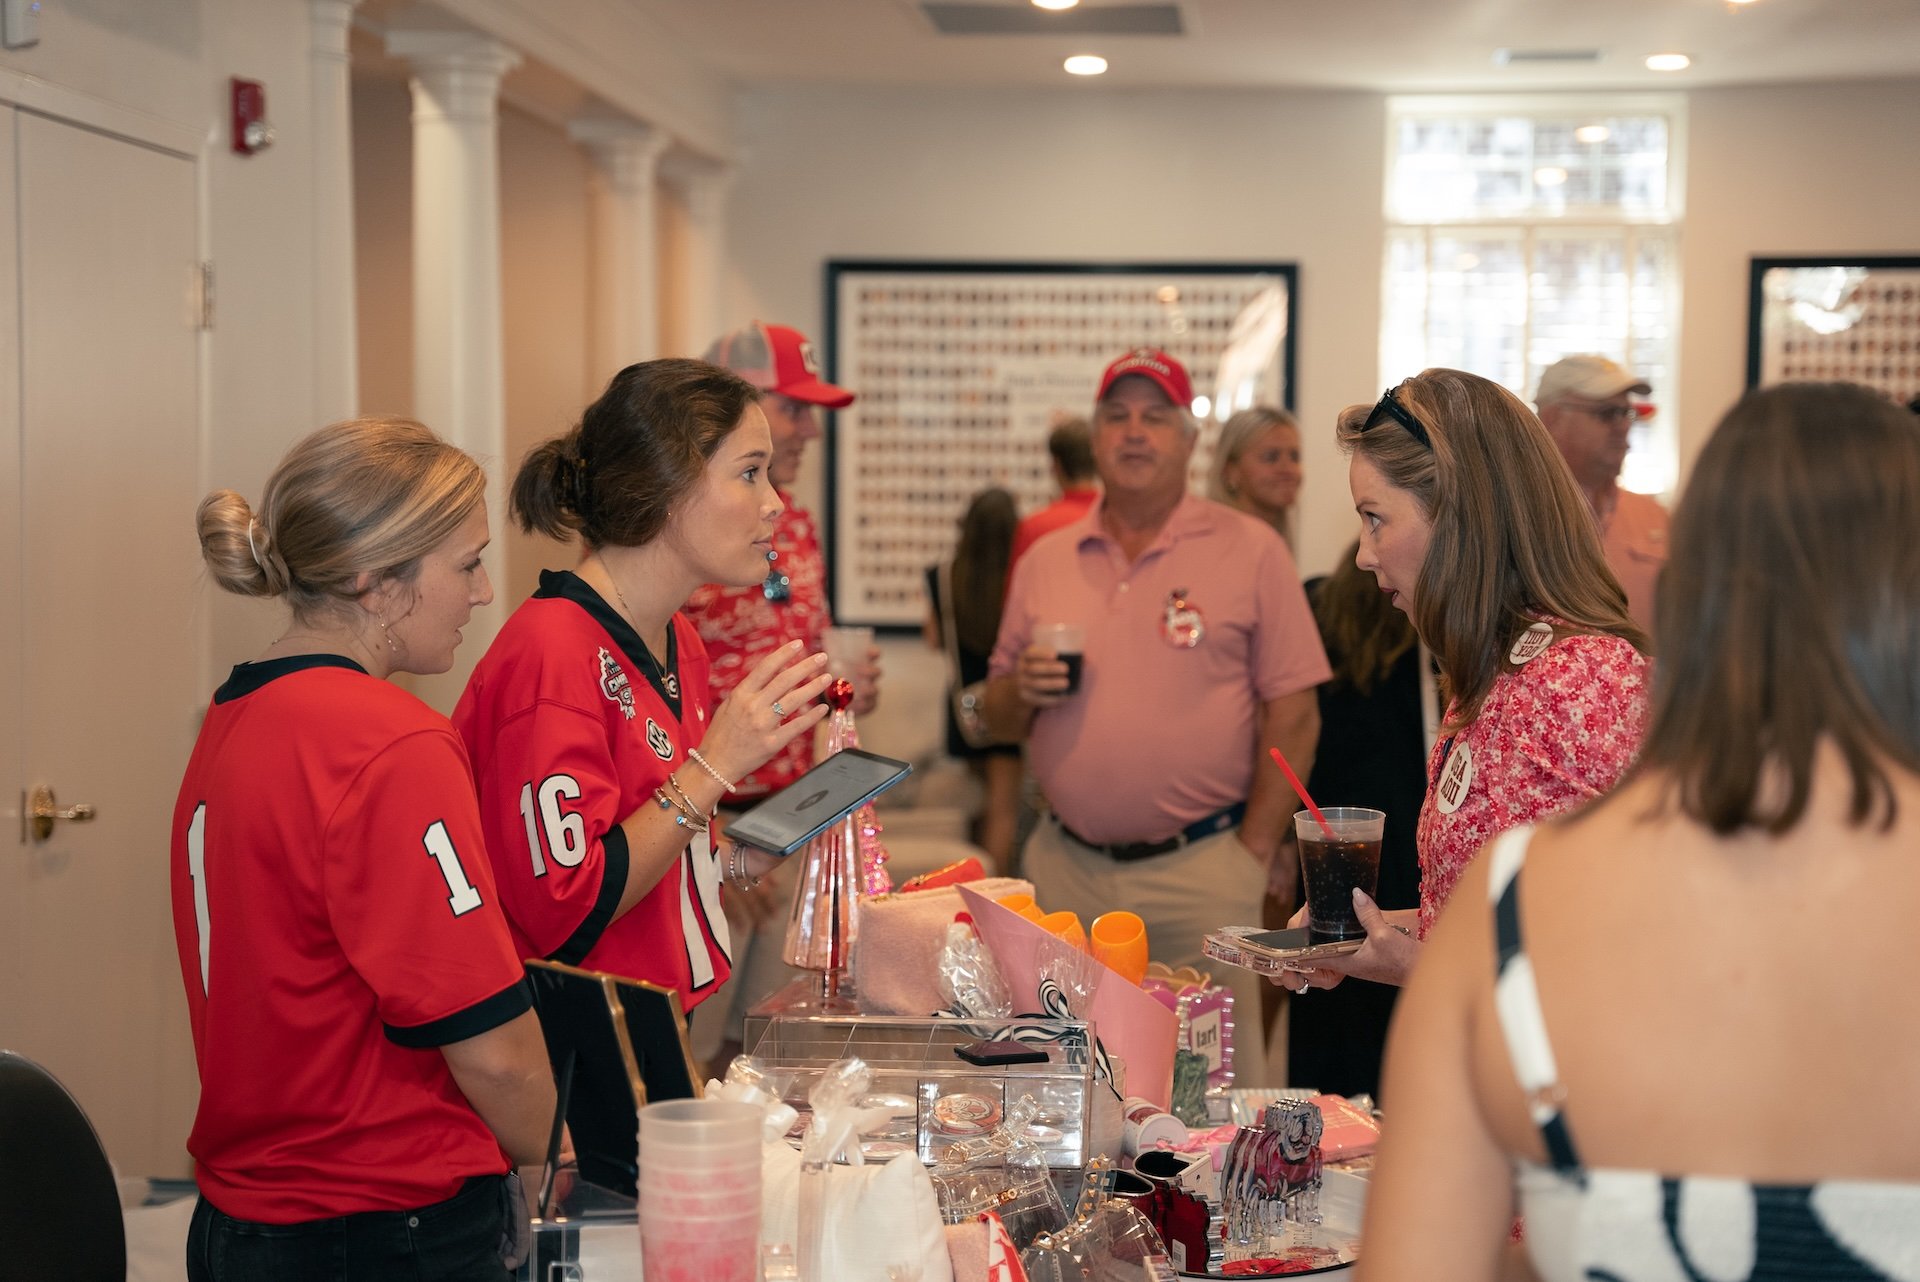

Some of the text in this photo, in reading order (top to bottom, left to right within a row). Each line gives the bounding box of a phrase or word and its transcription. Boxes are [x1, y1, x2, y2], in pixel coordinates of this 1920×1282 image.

[1451, 750, 1467, 783] UGA
[421, 818, 484, 919] 1
[519, 773, 588, 879] 16
